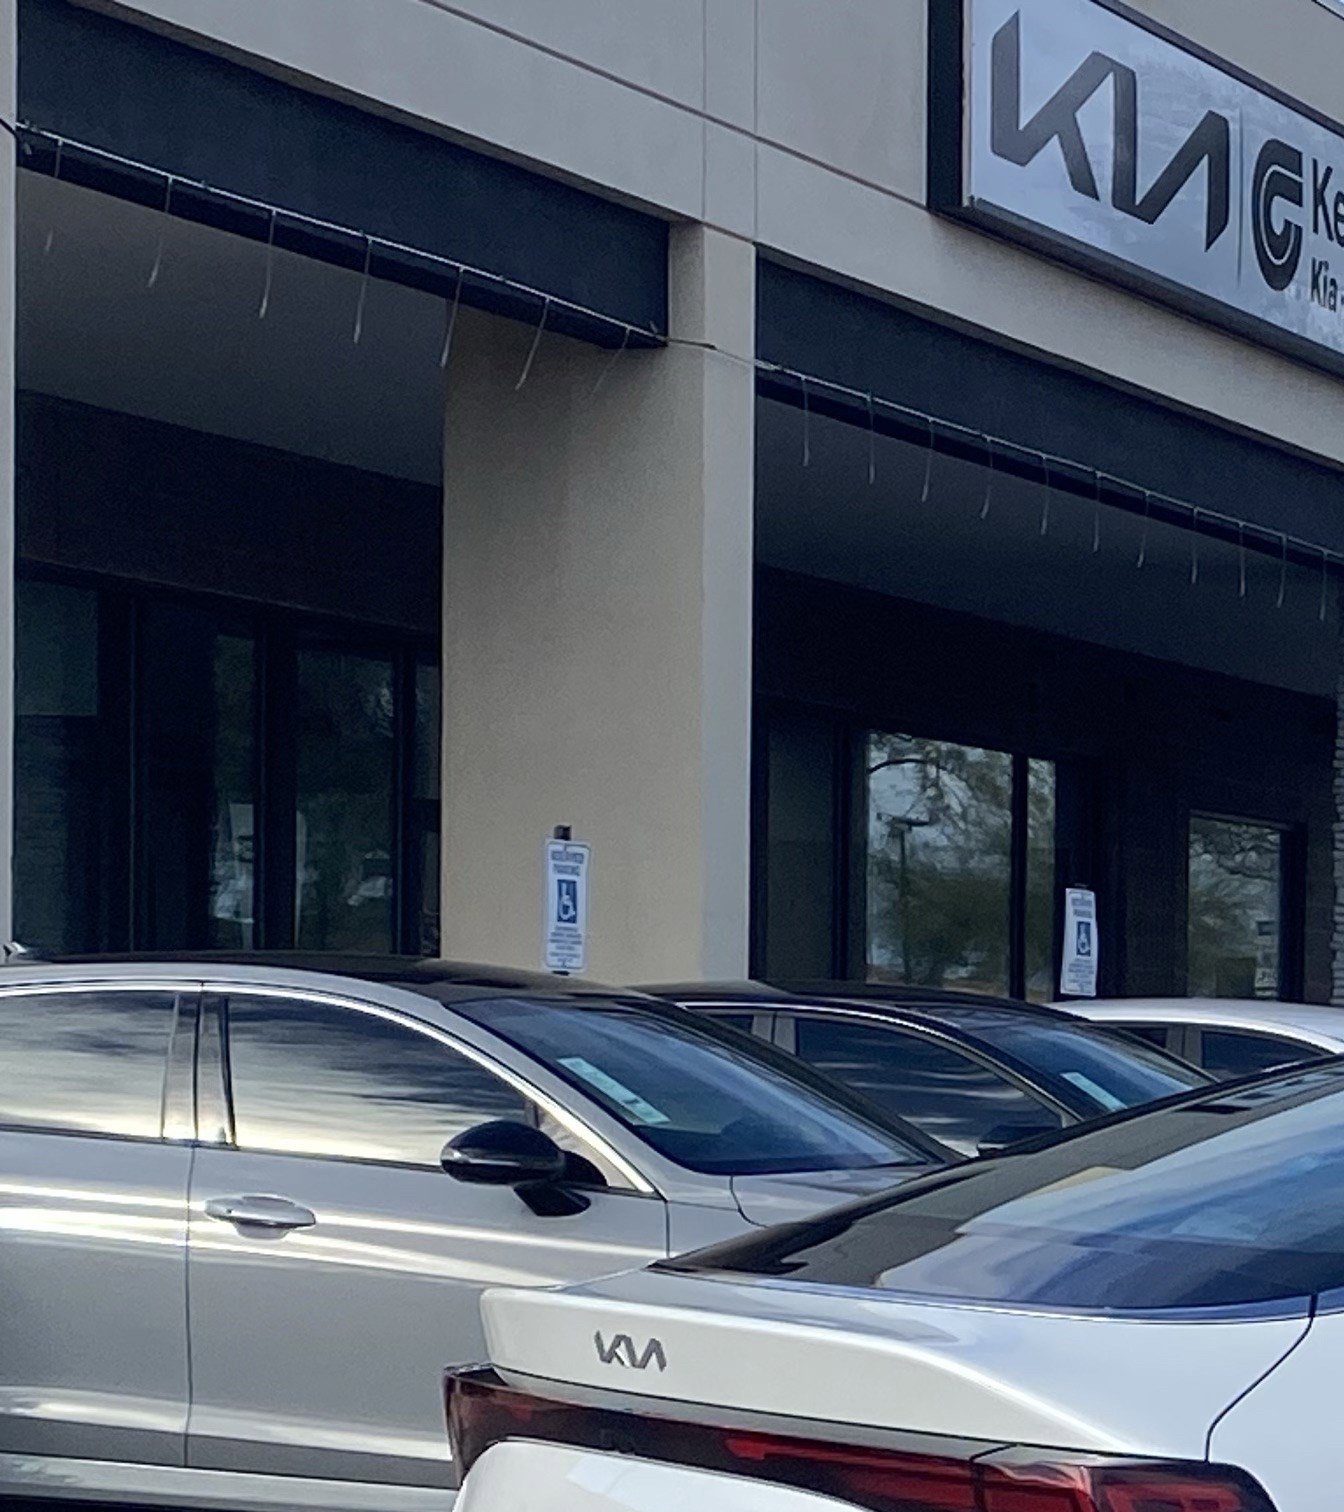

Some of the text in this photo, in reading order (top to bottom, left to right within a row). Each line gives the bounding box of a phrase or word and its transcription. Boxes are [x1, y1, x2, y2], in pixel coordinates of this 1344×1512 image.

[991, 9, 1230, 252] KIA
[1311, 256, 1338, 312] Kia
[594, 1329, 667, 1373] KIA
